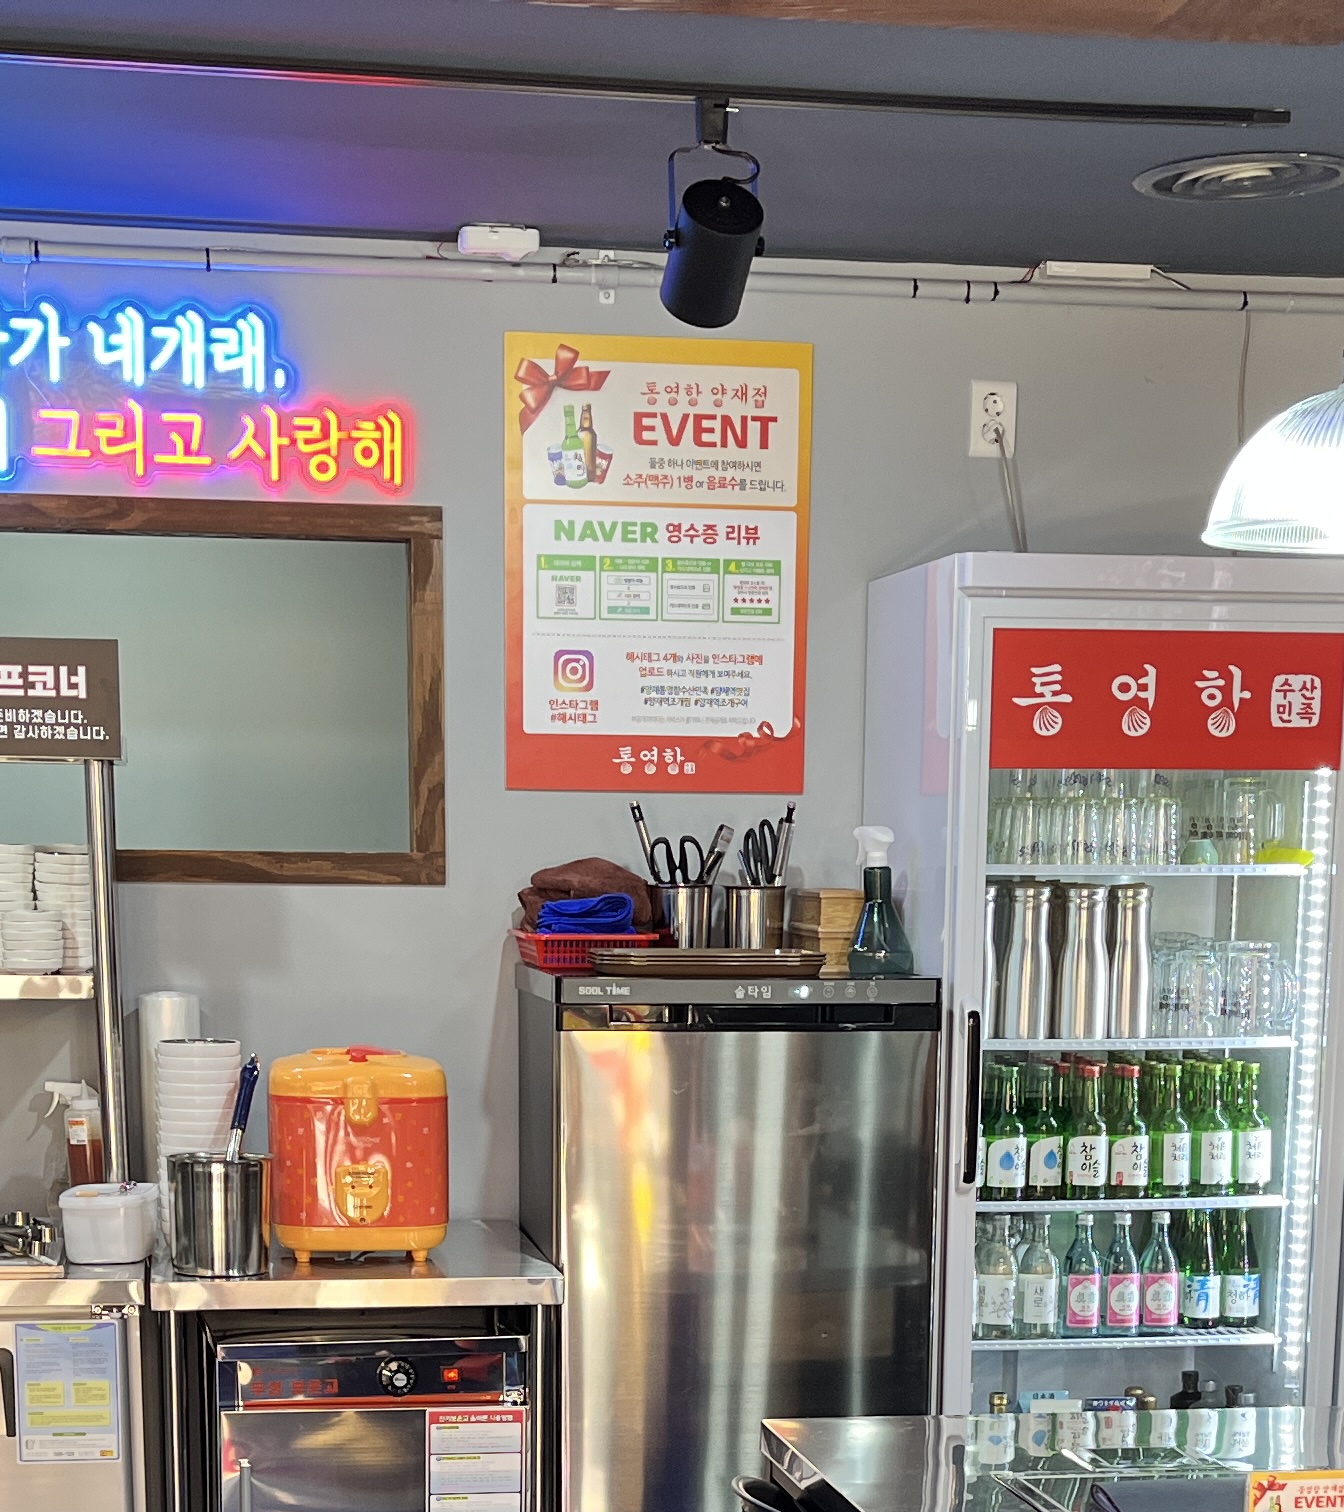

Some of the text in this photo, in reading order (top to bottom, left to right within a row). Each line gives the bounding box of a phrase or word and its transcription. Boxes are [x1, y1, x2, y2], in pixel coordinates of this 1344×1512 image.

[640, 381, 768, 409] 통영항 양재점
[31, 399, 212, 479] 그리고
[227, 406, 407, 488] 사랑해
[633, 411, 778, 450] EVENT
[676, 475, 694, 490] 1병
[695, 480, 705, 489] or
[706, 475, 747, 491] 음료수를
[554, 520, 761, 546] NAVER 영수증 리뷰
[639, 666, 665, 678] 업로드
[549, 698, 599, 711] 인스타그램
[1011, 663, 1252, 739] 통영항
[13, 724, 109, 740] 감사하겠습니다.
[612, 746, 685, 775] 통영항
[578, 983, 630, 996] SOOL TIME
[1080, 1142, 1101, 1179] 참이슬
